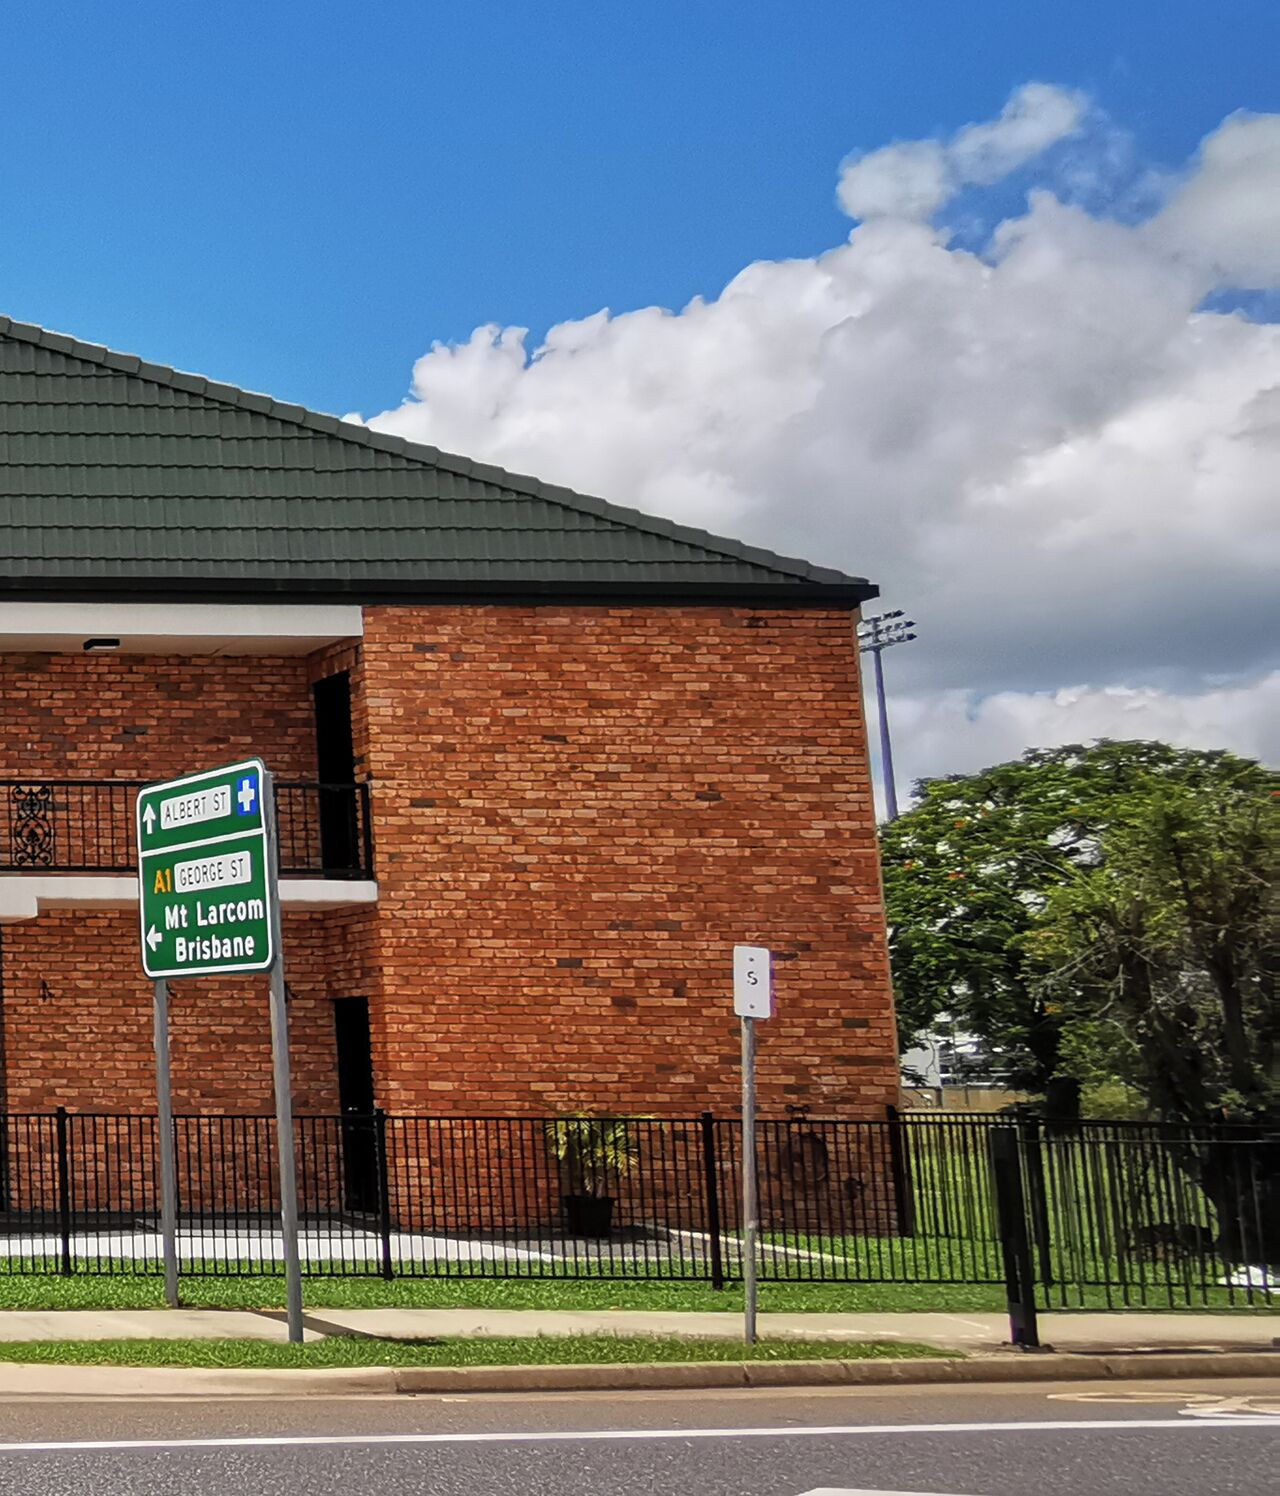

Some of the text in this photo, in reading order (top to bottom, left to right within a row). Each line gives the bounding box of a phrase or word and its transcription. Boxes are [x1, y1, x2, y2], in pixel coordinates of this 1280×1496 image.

[164, 791, 227, 823] ALBERT ST
[153, 858, 244, 895] A1 GEORGE ST
[164, 898, 264, 930] Mt Larcom
[175, 933, 255, 963] Brisbane
